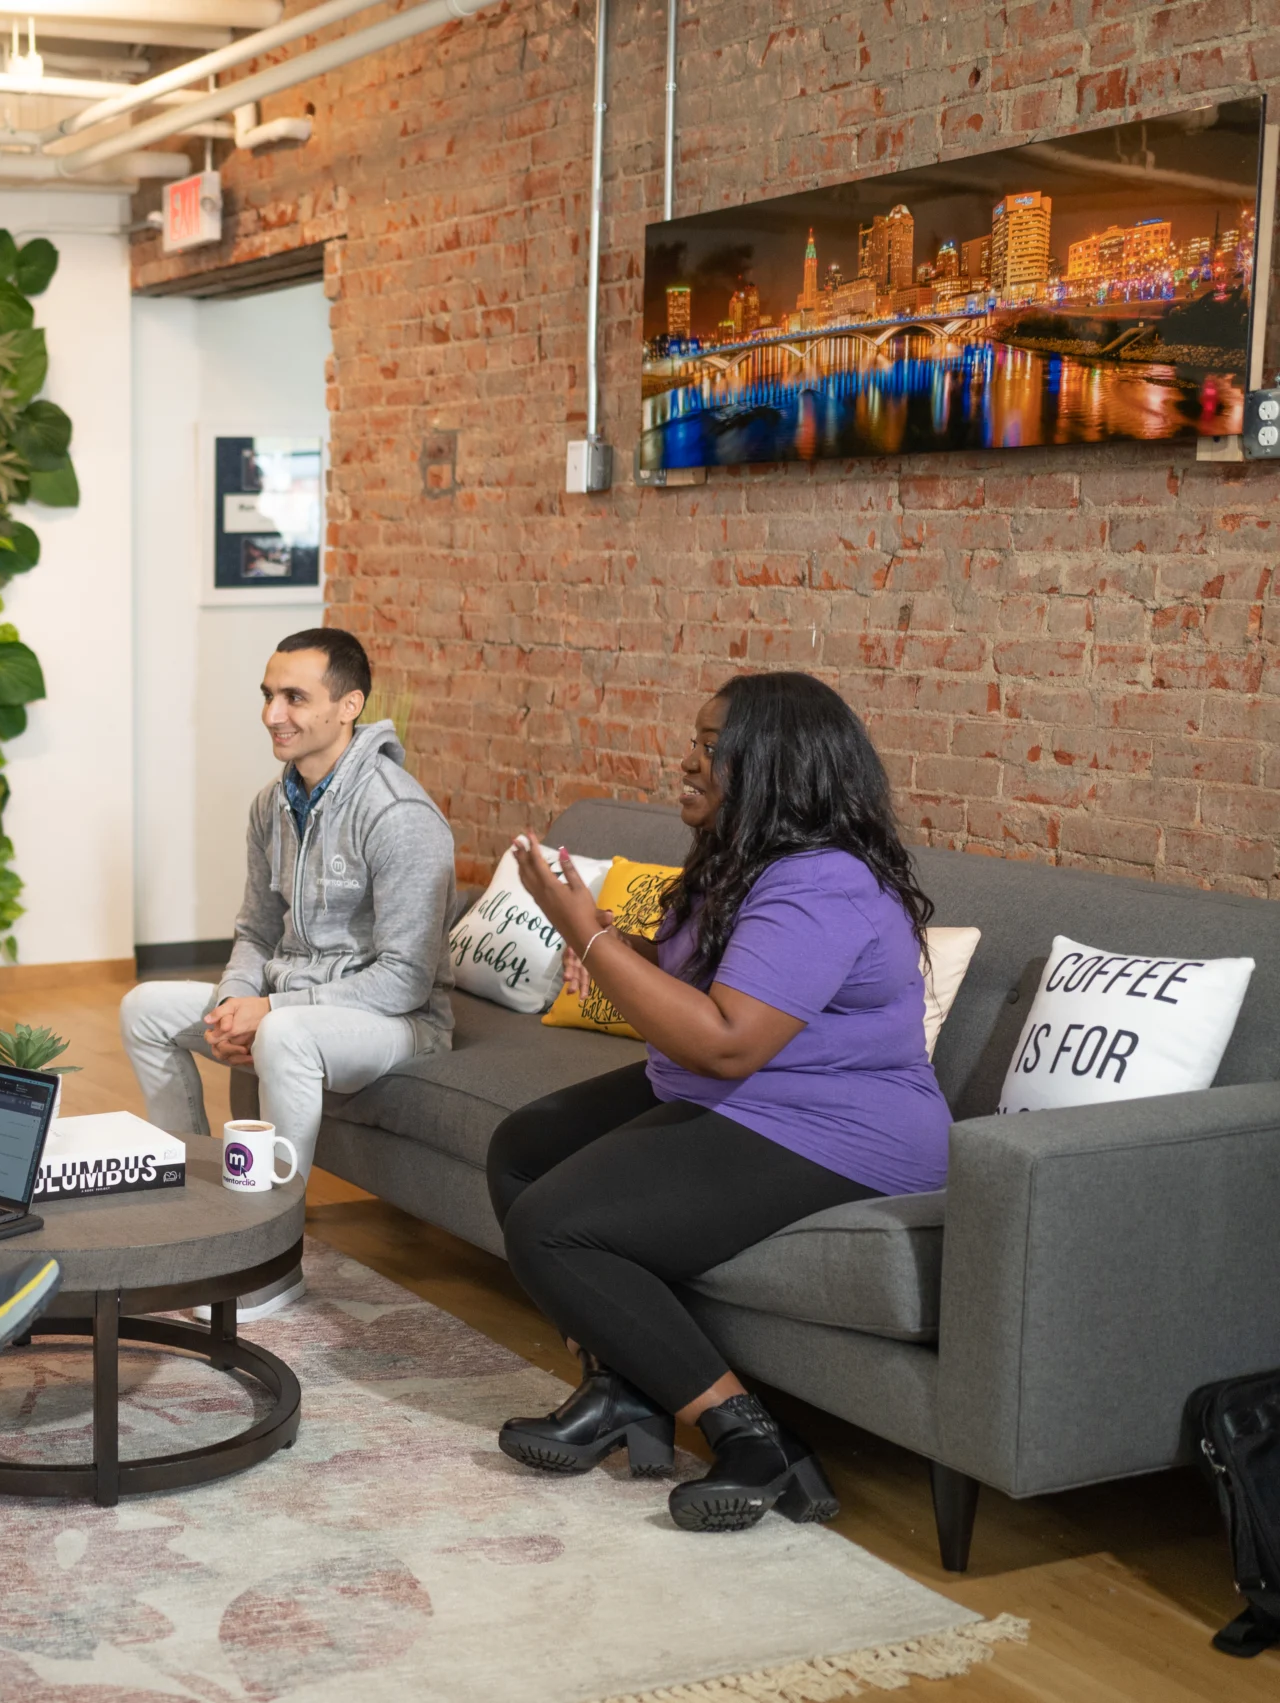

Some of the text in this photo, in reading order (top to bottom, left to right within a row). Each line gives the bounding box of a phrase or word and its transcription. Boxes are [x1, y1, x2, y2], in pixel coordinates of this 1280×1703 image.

[169, 175, 202, 241] EXIT
[478, 890, 513, 922] all
[472, 932, 531, 988] baby.
[1045, 952, 1206, 1005] COFFEE
[1014, 1023, 1140, 1084] IS FOR
[33, 1154, 158, 1195] OLUMBUS
